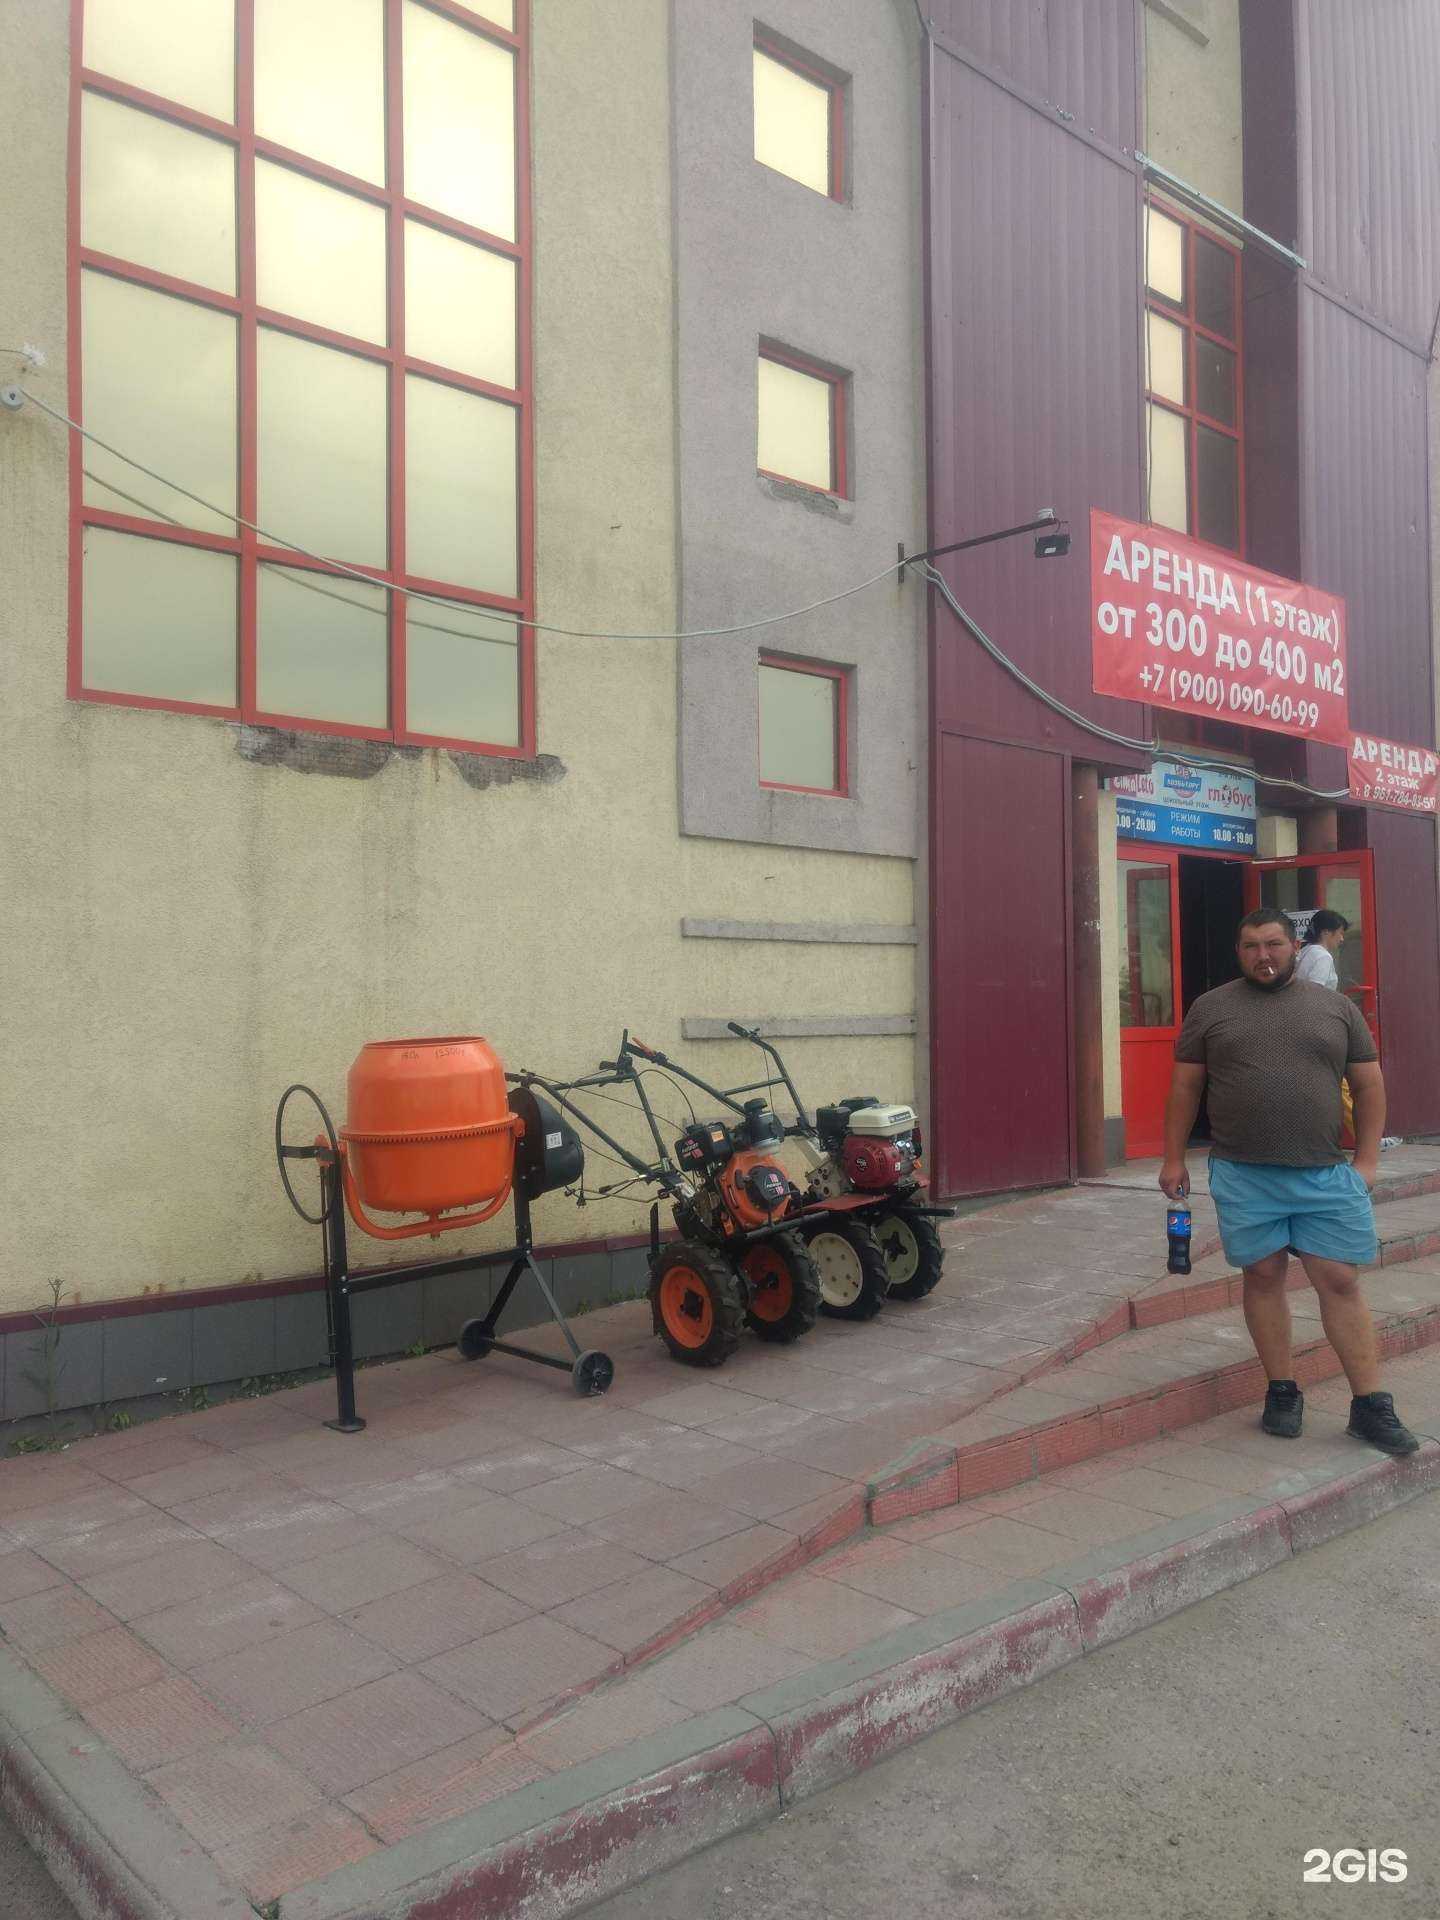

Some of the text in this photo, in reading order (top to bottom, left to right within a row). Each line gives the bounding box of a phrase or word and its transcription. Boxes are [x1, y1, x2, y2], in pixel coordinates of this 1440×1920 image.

[1102, 534, 1240, 616] АРЕНДА
[1097, 602, 1344, 697] от 300 до 400 м2
[1139, 663, 1320, 728] +7 (900) 090-60-99
[1352, 736, 1437, 778] АРЕНДА
[1375, 768, 1420, 791] 2 этаж
[1170, 811, 1201, 825] РЕЖИМ
[1171, 825, 1201, 840] РАБОТЫ
